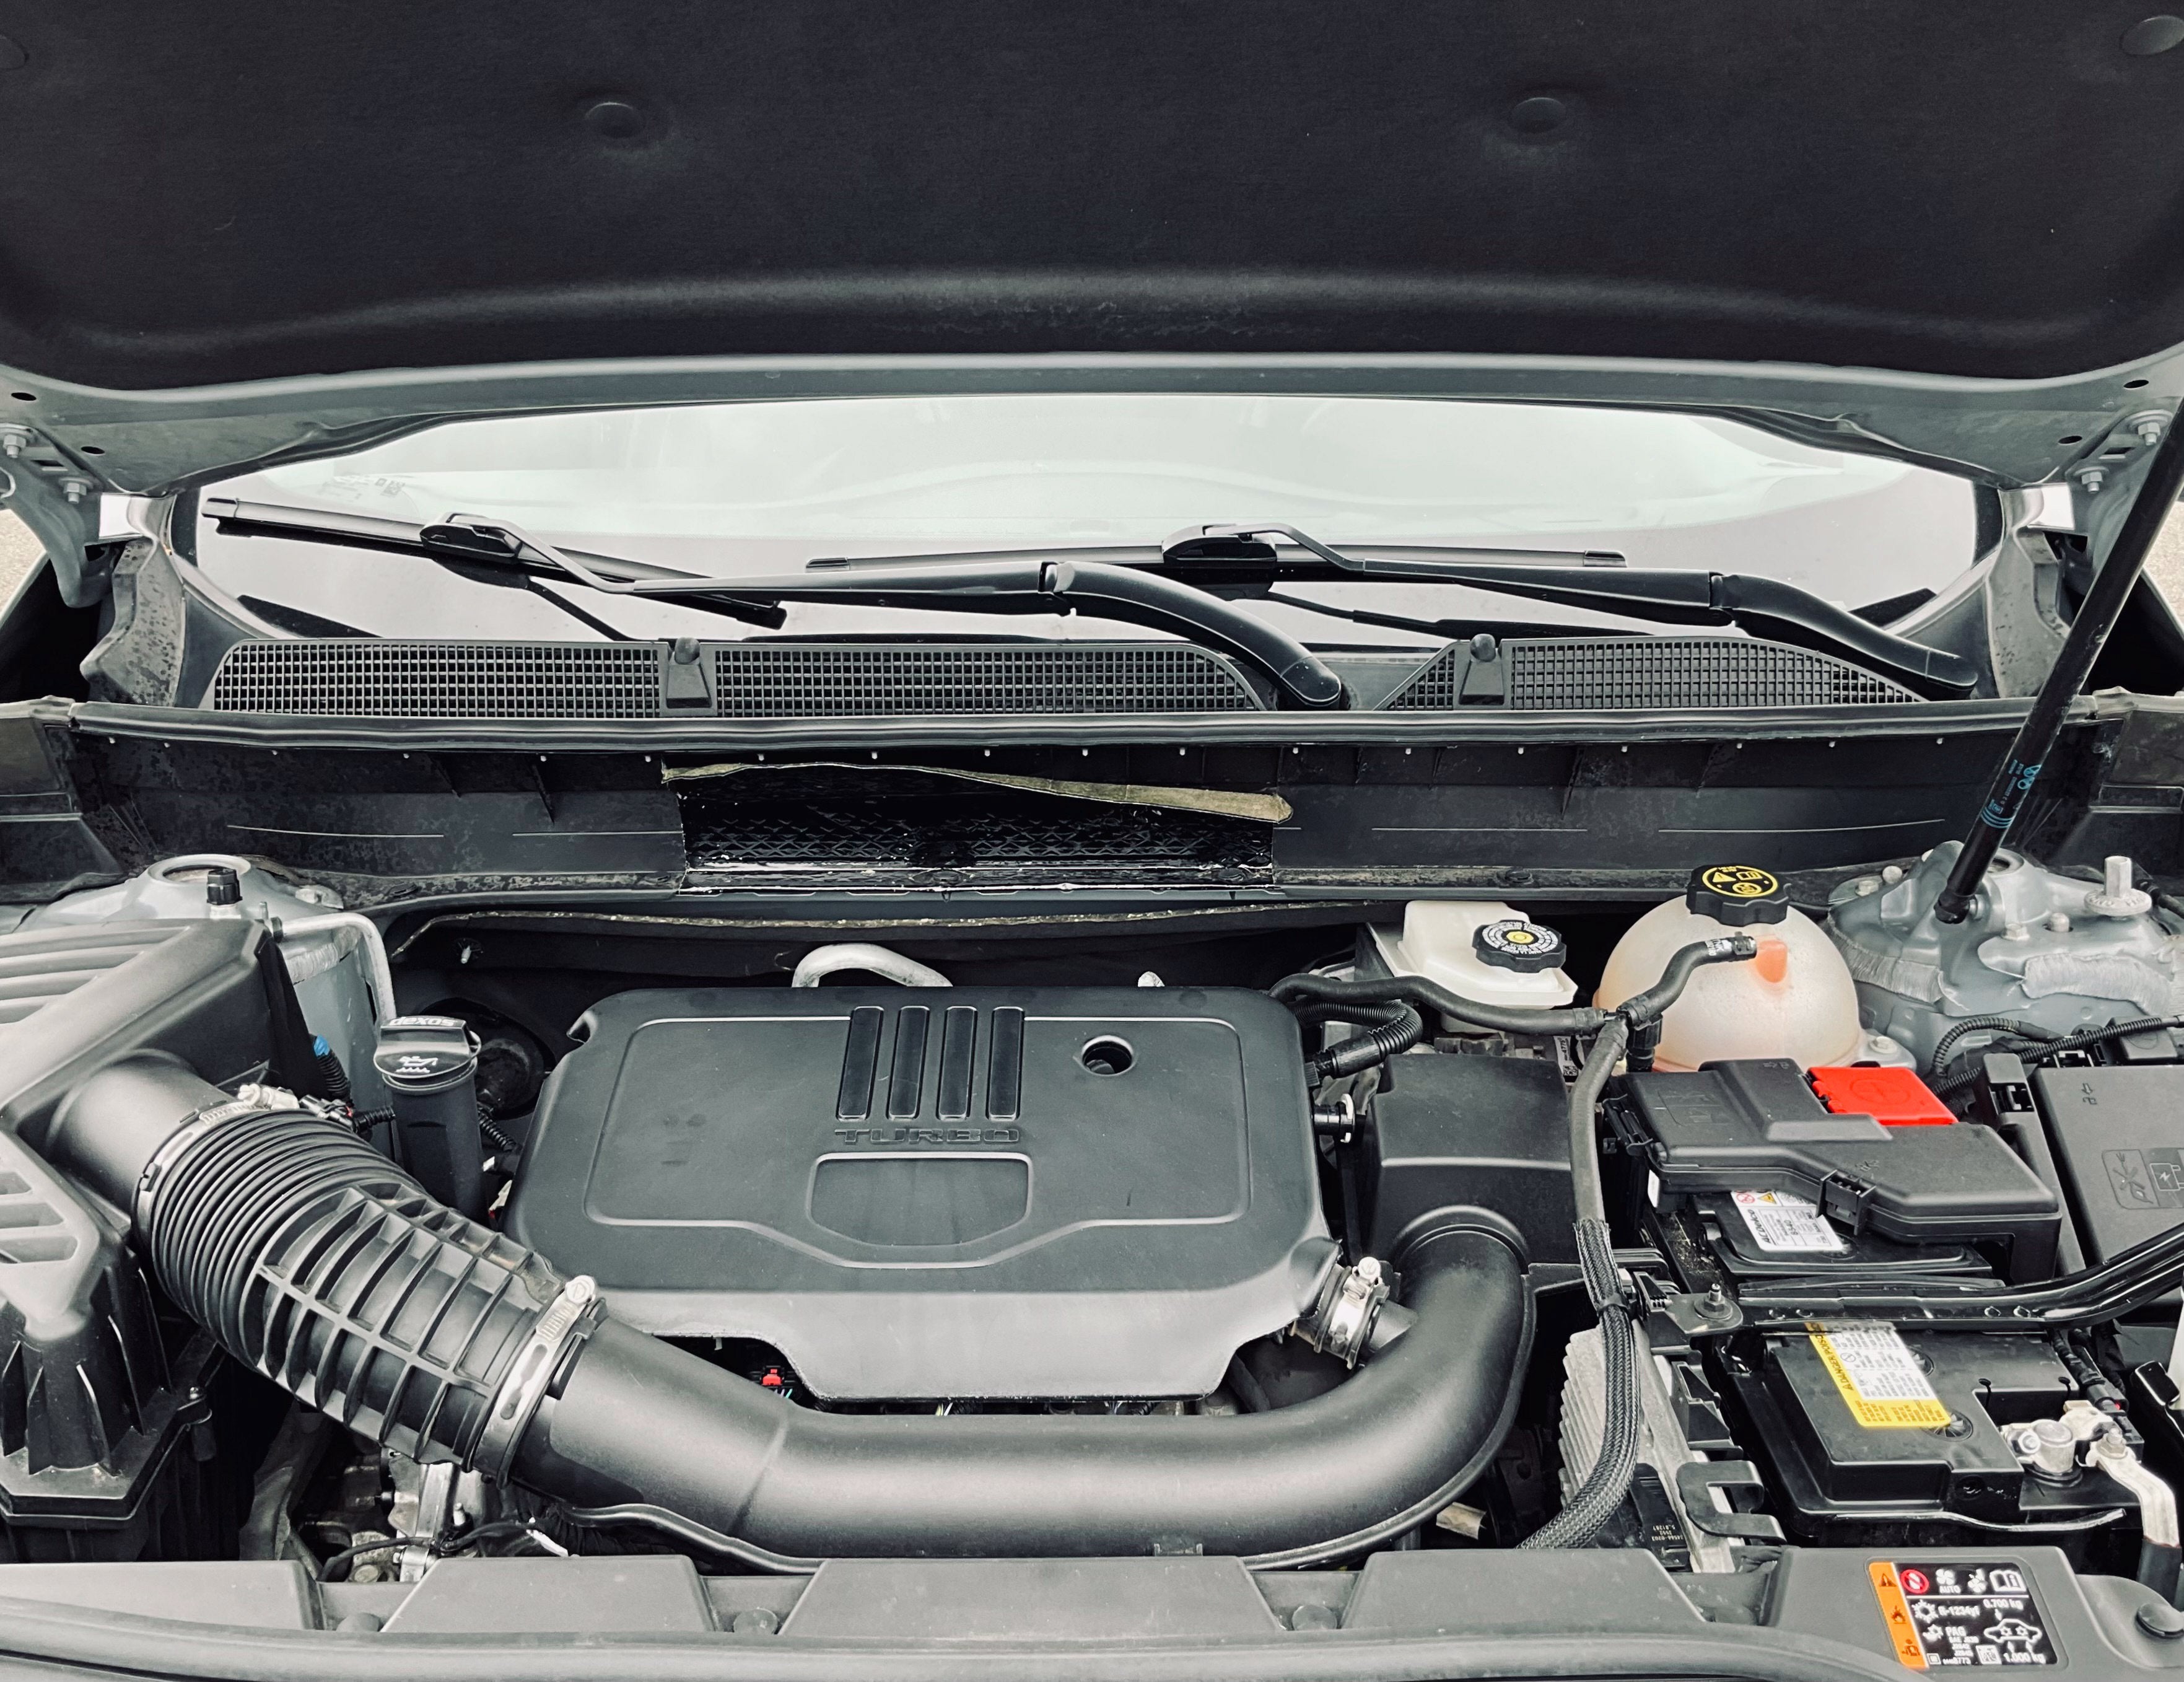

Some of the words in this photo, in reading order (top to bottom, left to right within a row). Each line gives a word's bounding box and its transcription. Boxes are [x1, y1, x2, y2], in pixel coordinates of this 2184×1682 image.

[389, 1017, 456, 1027] dexos
[834, 1128, 1020, 1144] TURBO
[1747, 1209, 1771, 1244] ACDelco
[1939, 1585, 1962, 1594] AUTO
[2009, 1599, 2024, 1610] kg
[1945, 1626, 1967, 1637] PAG
[2030, 1654, 2046, 1665] kg
